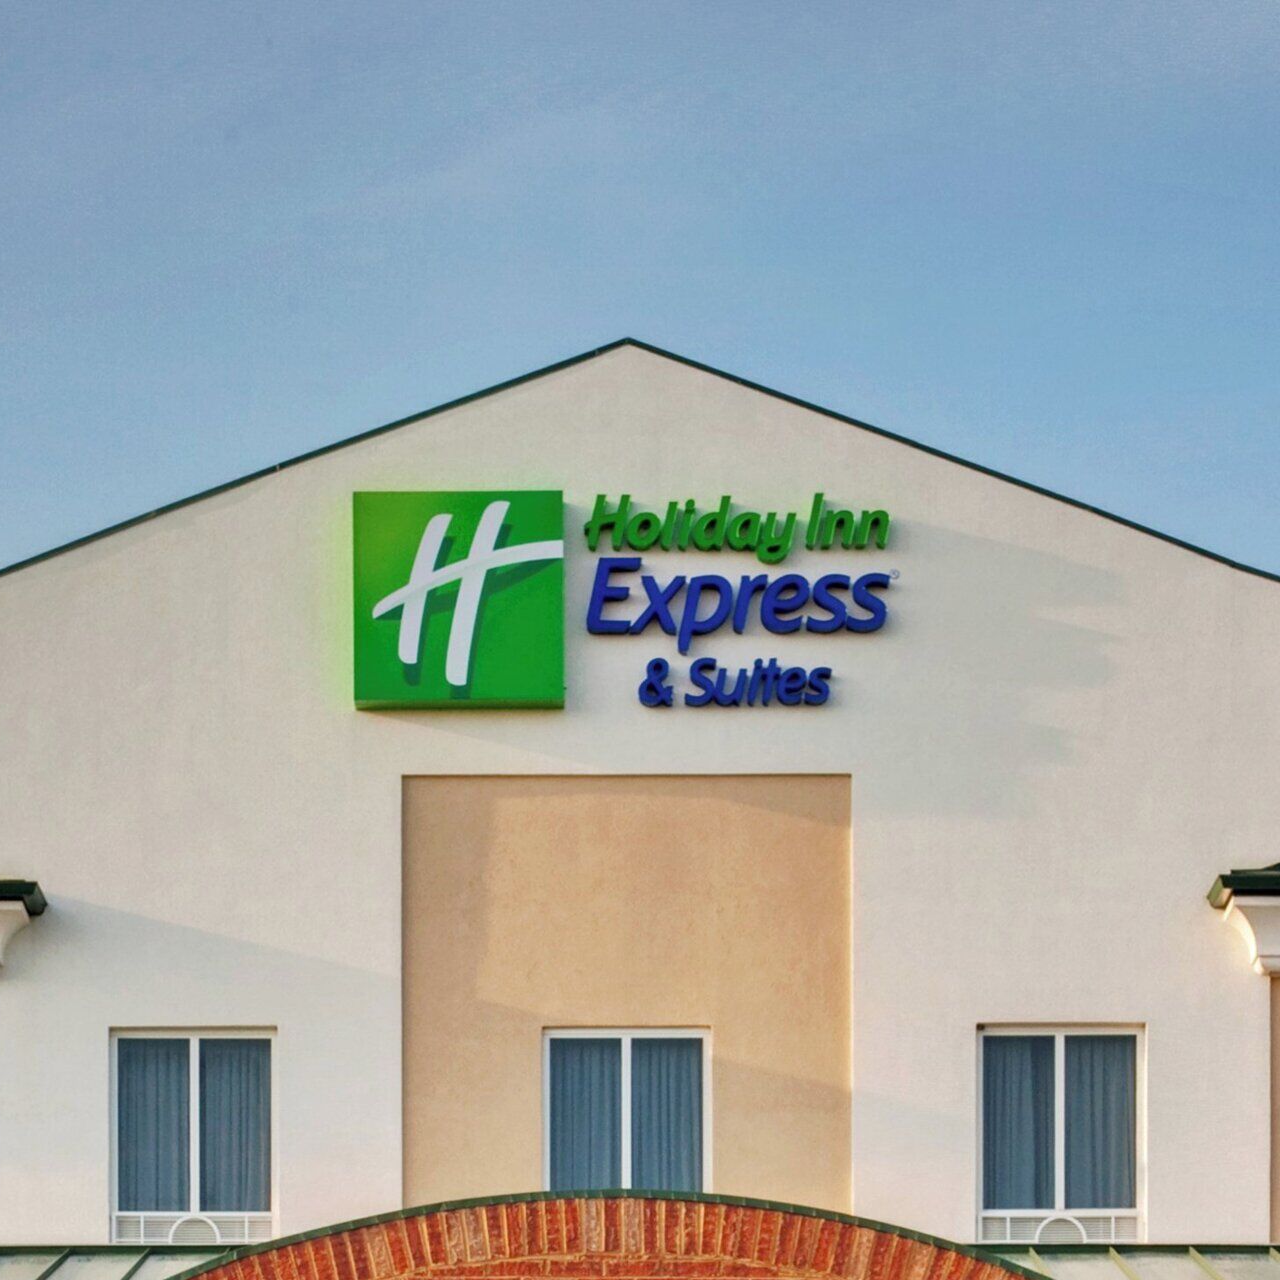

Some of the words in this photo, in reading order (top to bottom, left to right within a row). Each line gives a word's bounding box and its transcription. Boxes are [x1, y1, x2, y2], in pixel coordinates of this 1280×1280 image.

[584, 494, 796, 564] Holiday
[806, 492, 890, 549] Inn
[638, 657, 674, 708] &
[684, 657, 832, 708] Suites
